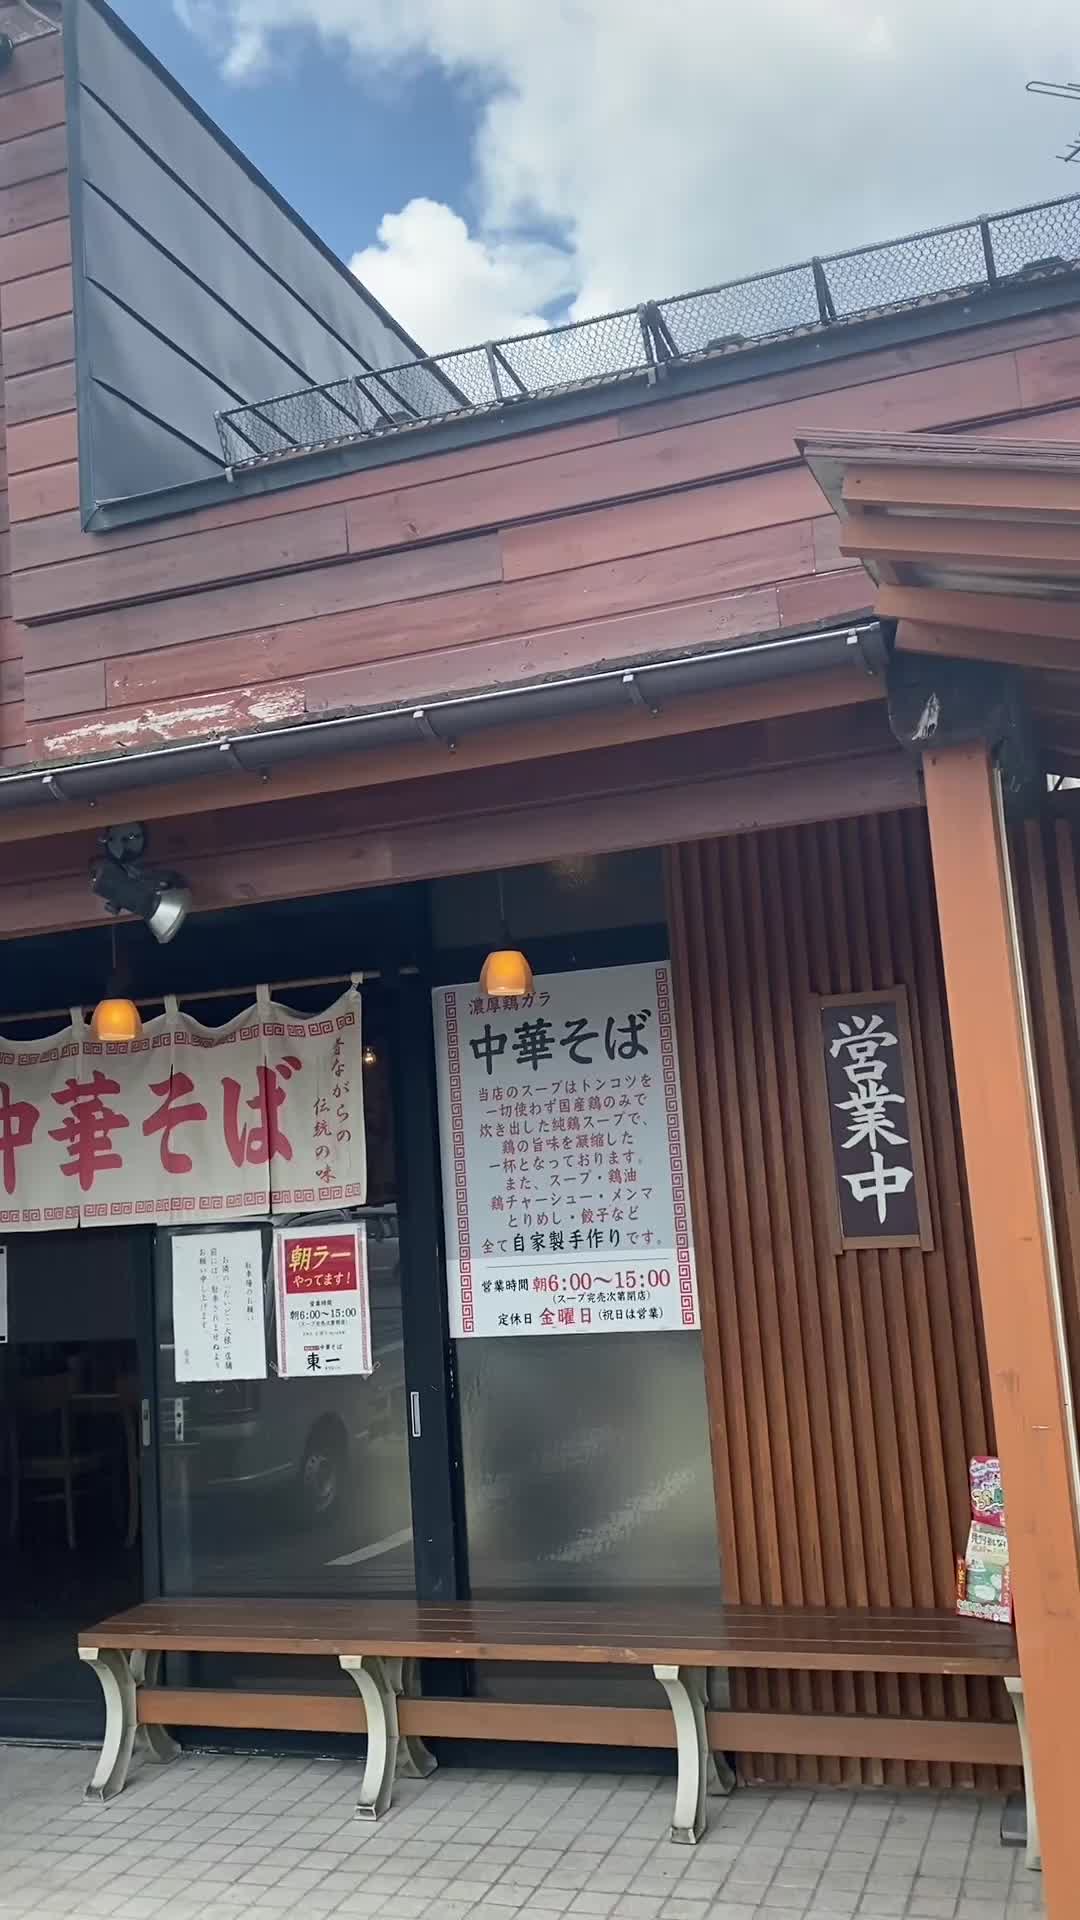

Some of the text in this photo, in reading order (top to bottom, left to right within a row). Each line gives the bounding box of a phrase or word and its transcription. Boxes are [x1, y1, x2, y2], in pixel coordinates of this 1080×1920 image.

[469, 990, 550, 1015] 濃厚鶏ガラ
[469, 1008, 652, 1075] 中華そば
[478, 1073, 652, 1102] 当店のスープはトンコツを
[486, 1093, 647, 1119] 一切使わず国産鶏のみで
[0, 1056, 303, 1195] 中華そば
[479, 1112, 648, 1138] 炊き出した純鶏スープで、
[829, 1014, 914, 1224] 営業中
[313, 1097, 336, 1184] 伝統の味
[502, 1130, 633, 1155] 鶏の旨味を凝縮した
[489, 1150, 643, 1174] 一杯となっております。
[490, 1187, 652, 1211] 鶏チャーシュー・メンマ
[508, 1206, 639, 1228] とりめし・餃子など
[482, 1228, 662, 1254] 全て自家製手作りです。
[289, 1244, 351, 1272] 朝ラー
[293, 1272, 351, 1288] やってます!
[481, 1278, 529, 1293] 営業時間
[498, 1307, 664, 1326] 定休日 金曜日 (祝日は営業)
[306, 1352, 341, 1372] 東一
